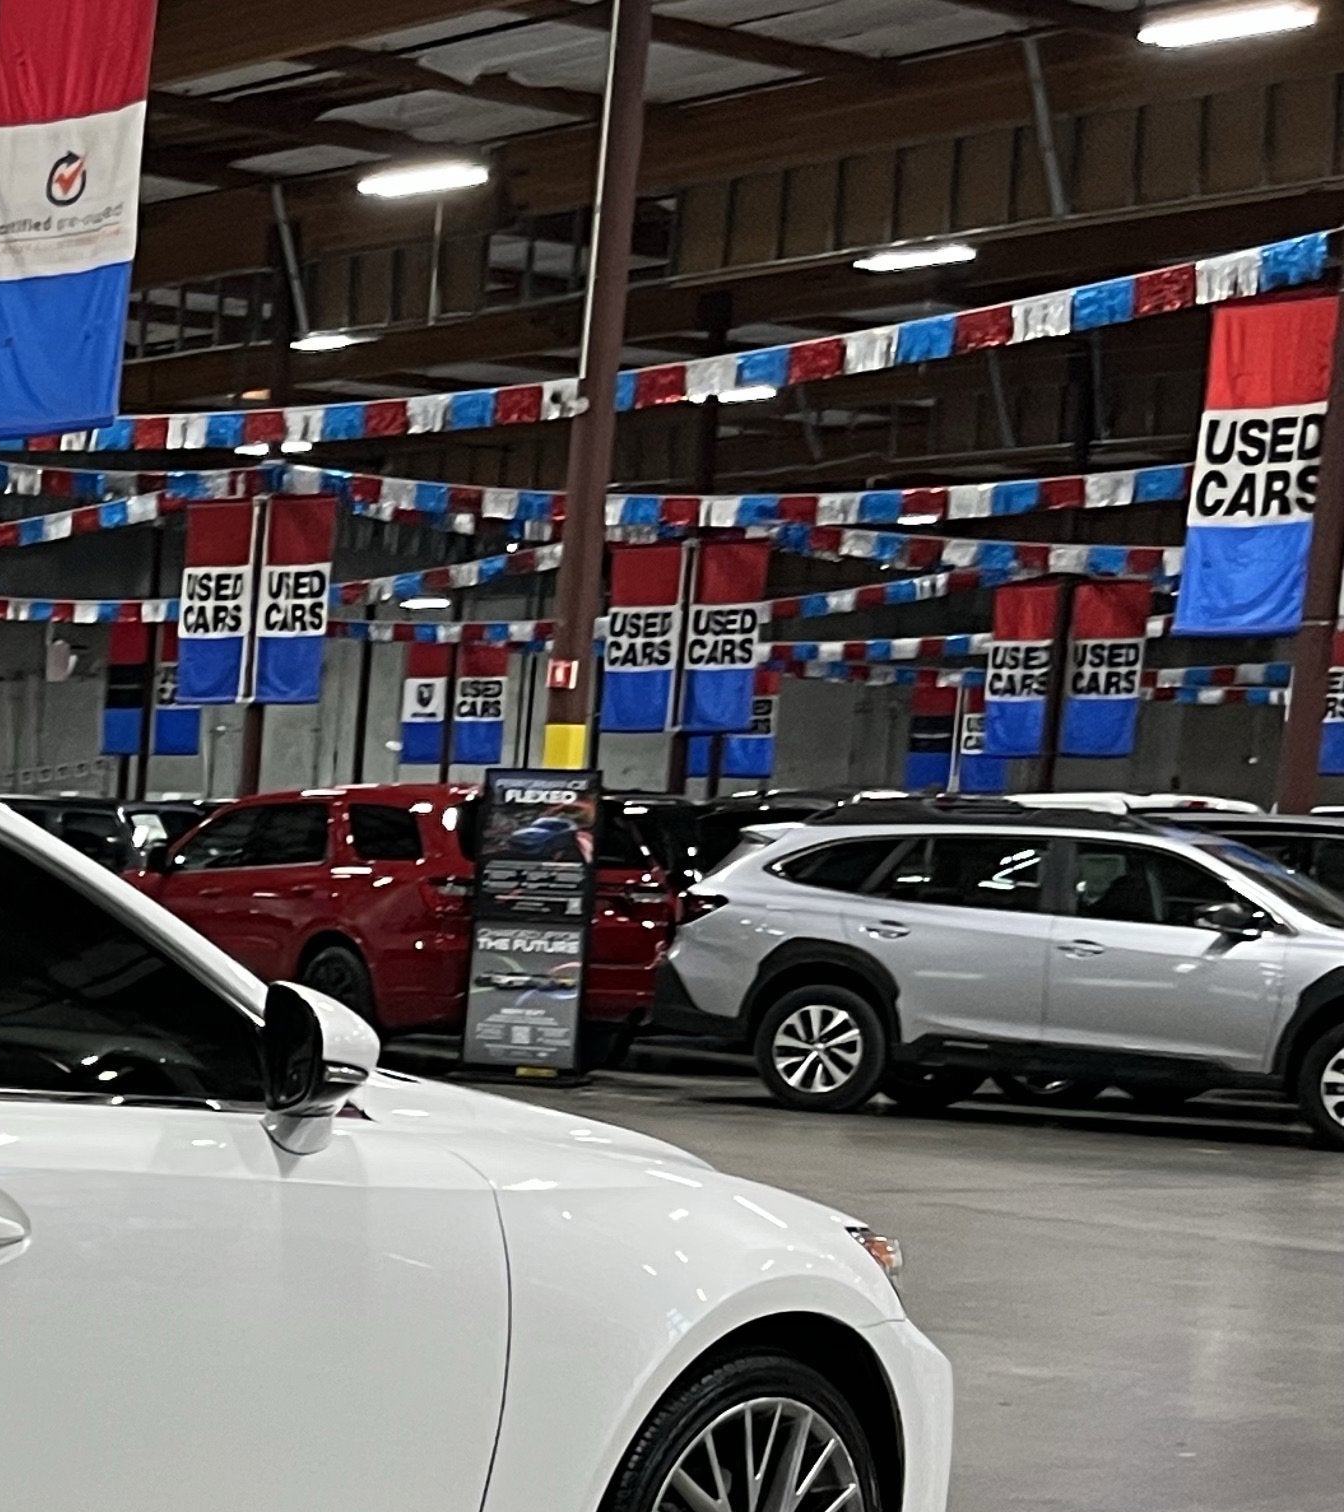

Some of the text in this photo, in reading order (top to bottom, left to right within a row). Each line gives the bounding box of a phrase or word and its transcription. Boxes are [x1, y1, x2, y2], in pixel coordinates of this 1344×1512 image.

[1205, 413, 1328, 466] USED
[1196, 465, 1321, 517] CARS
[184, 604, 242, 633] CARS
[610, 611, 672, 639] USED
[693, 608, 758, 636] USED
[607, 640, 671, 667] CARS
[688, 638, 754, 666] CARS
[1071, 670, 1137, 695] CARS
